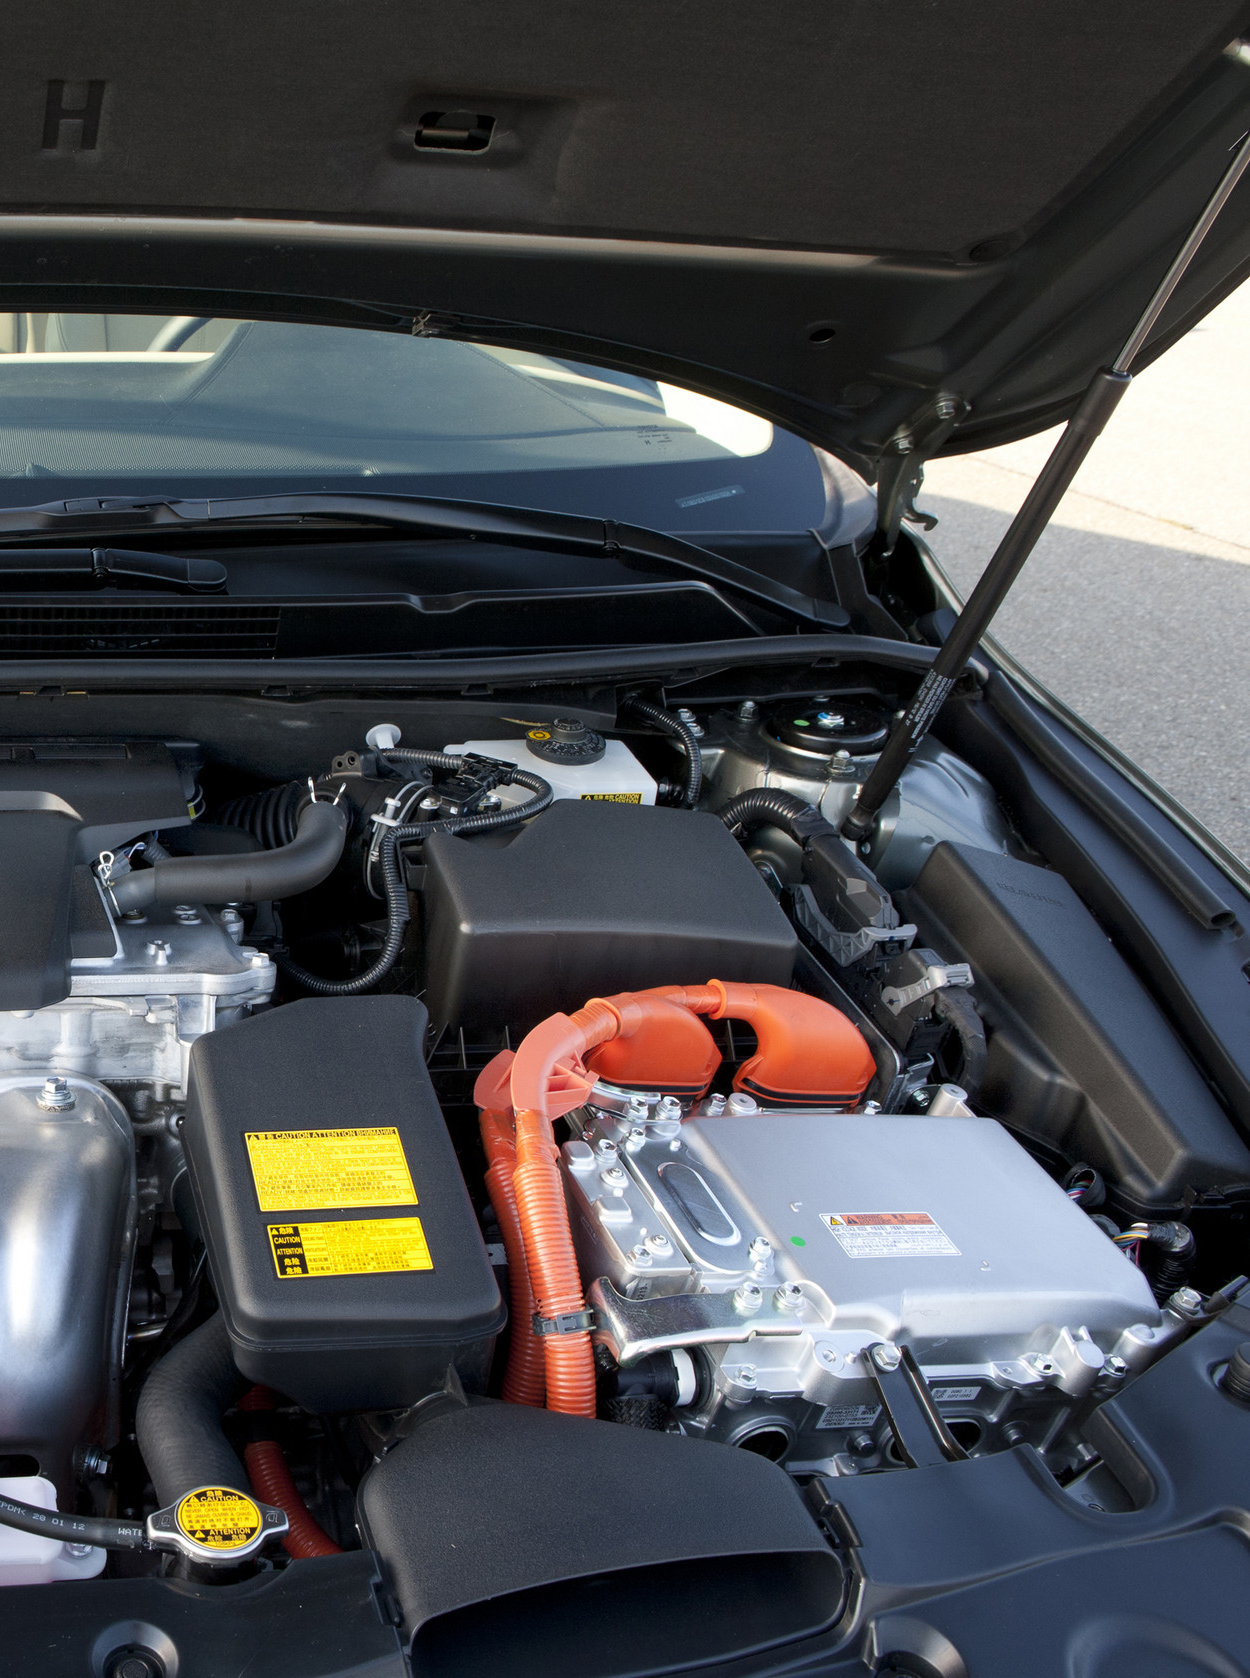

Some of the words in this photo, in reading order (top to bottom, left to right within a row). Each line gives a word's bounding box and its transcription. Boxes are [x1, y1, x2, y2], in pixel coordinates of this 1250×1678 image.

[41, 79, 106, 150] H
[275, 1132, 310, 1140] CAUTION
[312, 1130, 356, 1138] ATTENTION
[274, 1236, 300, 1244] CAUTION
[277, 1247, 303, 1255] ATTENTION
[32, 1512, 46, 1522] 28
[51, 1518, 64, 1526] 01
[72, 1522, 86, 1530] 12
[209, 1528, 250, 1536] ATTENTION
